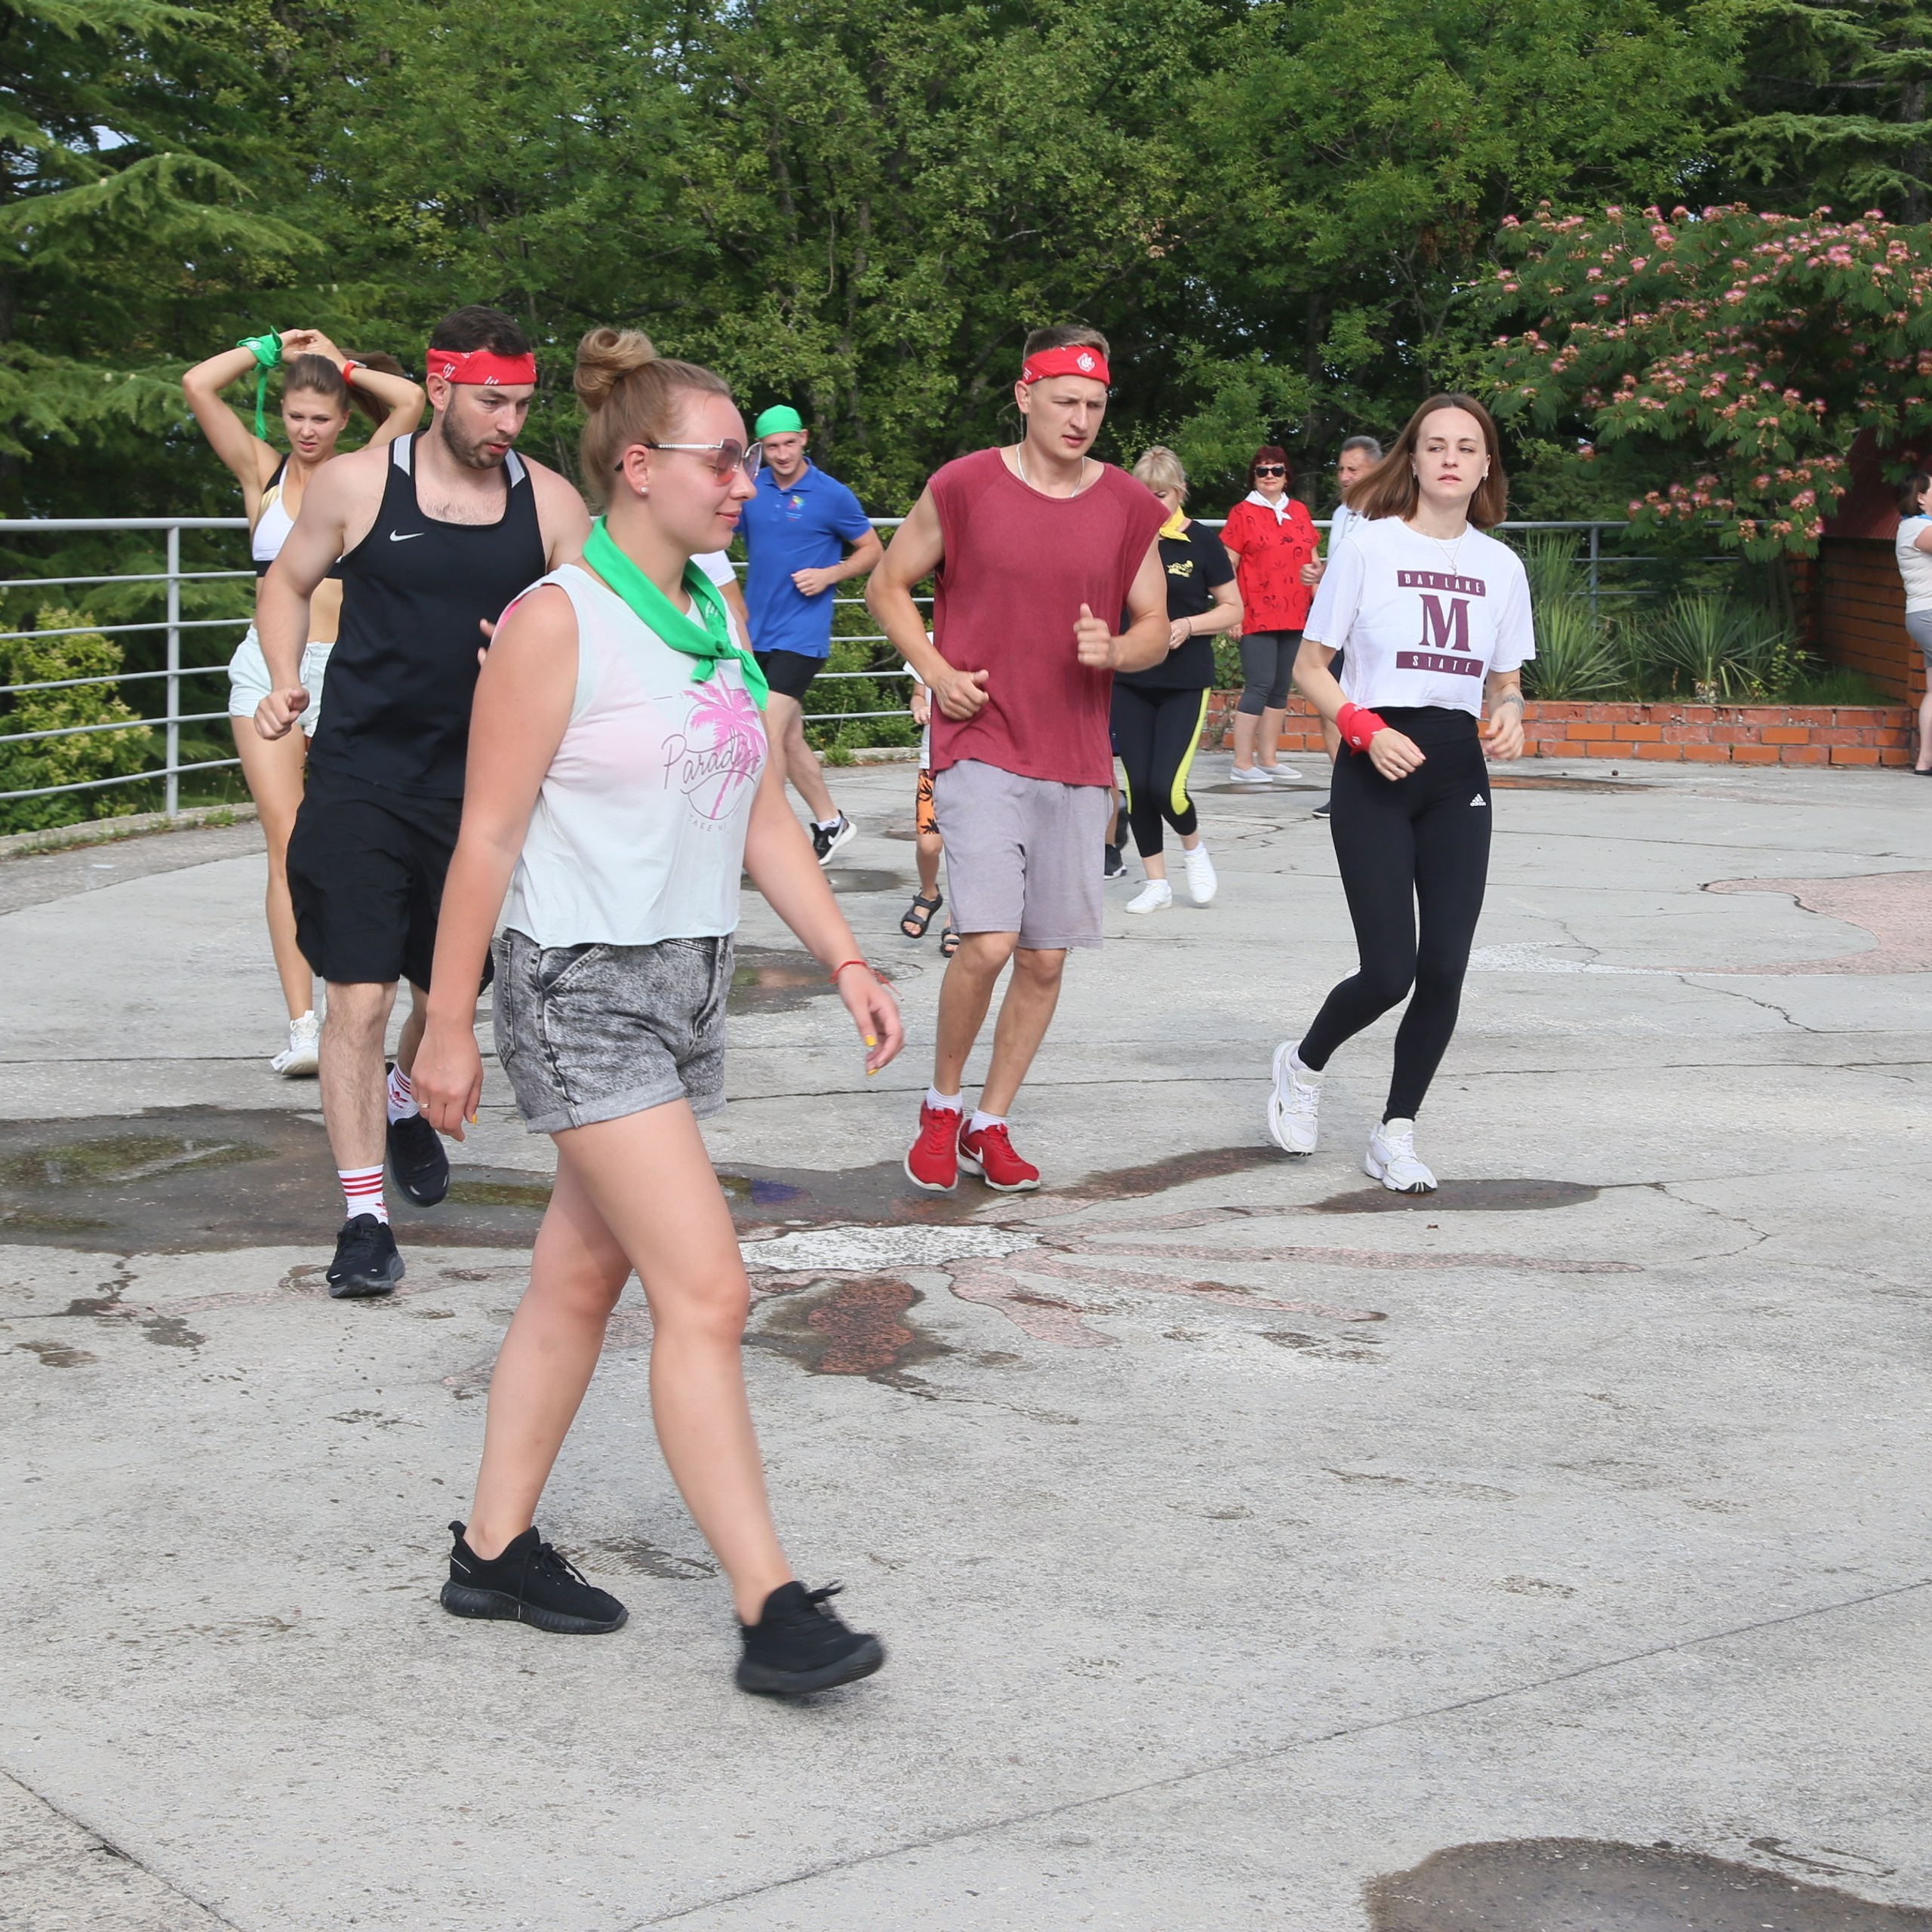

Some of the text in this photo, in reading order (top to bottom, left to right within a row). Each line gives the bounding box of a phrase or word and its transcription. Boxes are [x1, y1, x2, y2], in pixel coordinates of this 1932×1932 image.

[1404, 574, 1481, 593] BAY LAKE
[1418, 593, 1472, 652] M
[1412, 655, 1472, 672] STATE
